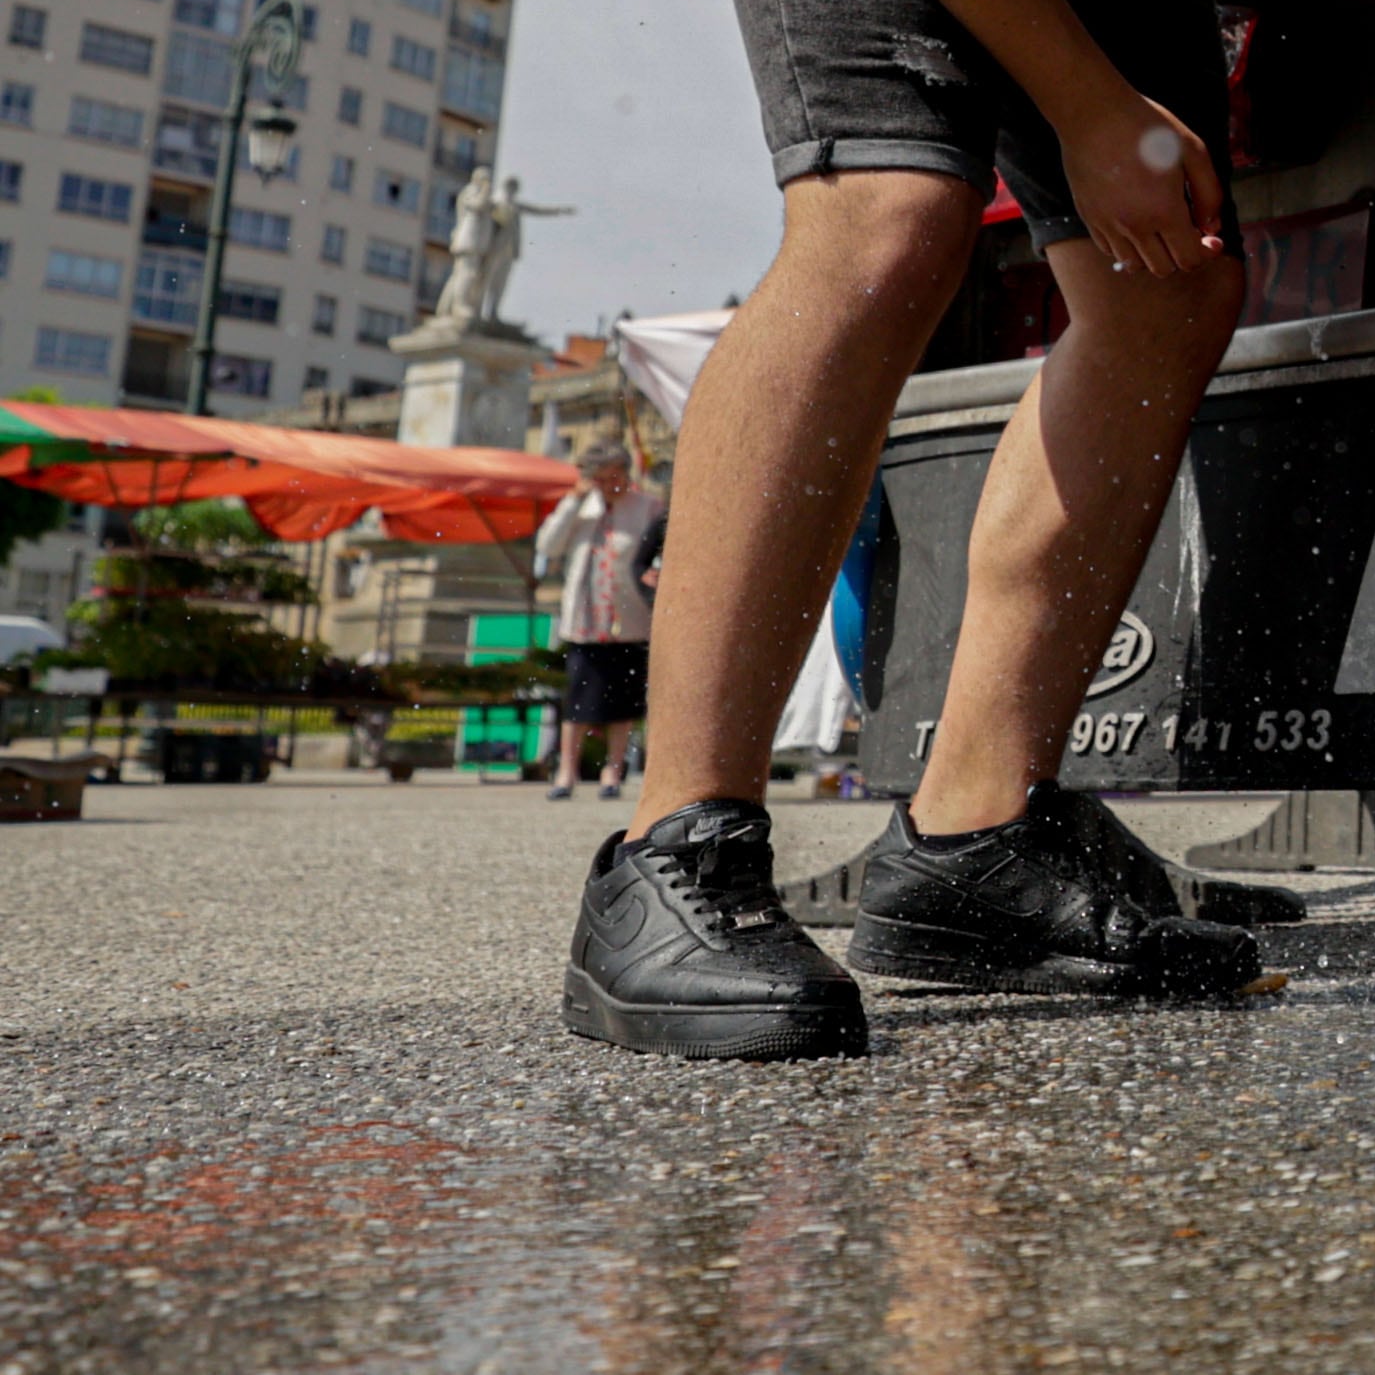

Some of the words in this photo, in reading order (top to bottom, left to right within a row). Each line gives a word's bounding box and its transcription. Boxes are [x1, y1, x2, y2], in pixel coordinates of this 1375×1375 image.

[1071, 712, 1145, 755] 967
[1161, 715, 1232, 752] 141
[1253, 709, 1333, 752] 533
